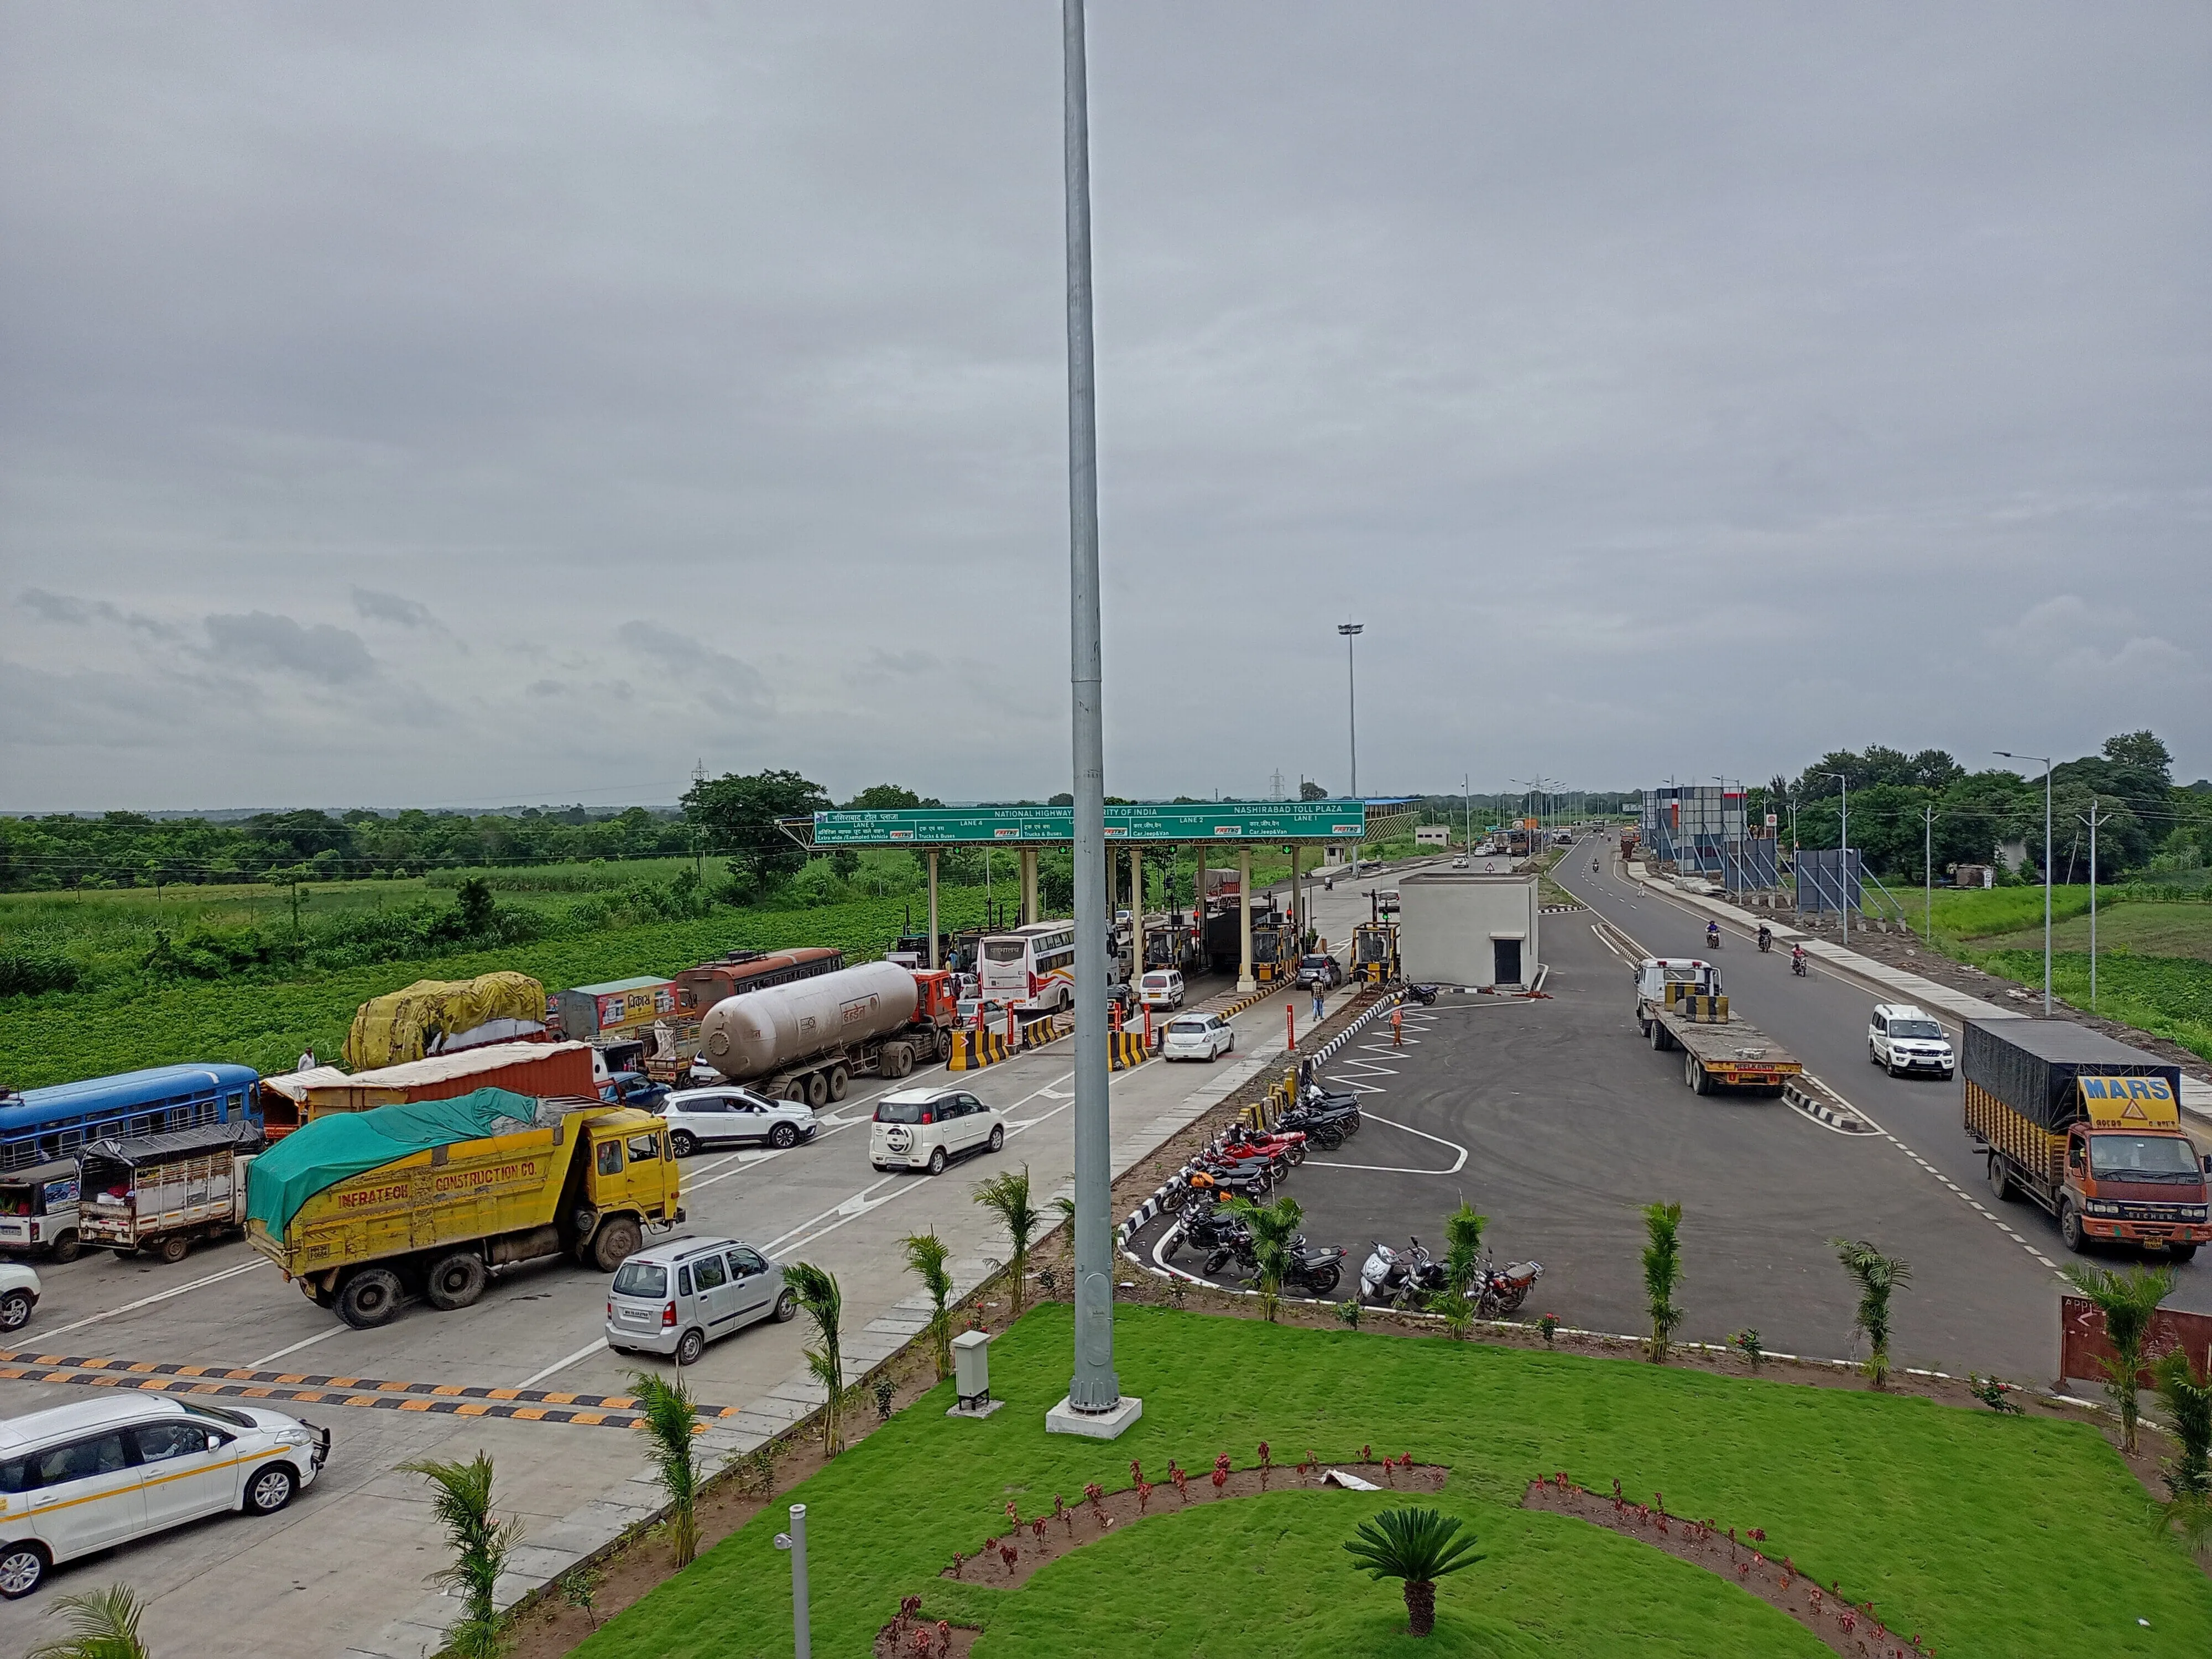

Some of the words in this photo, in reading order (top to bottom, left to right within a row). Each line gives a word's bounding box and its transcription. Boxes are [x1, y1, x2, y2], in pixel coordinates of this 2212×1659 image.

[832, 813, 861, 821] नसिराबाद
[864, 812, 877, 821] टोल
[2084, 1079, 2169, 1100] MARS
[435, 1165, 519, 1192] CONSTRUCTION
[521, 1161, 537, 1177] CO.
